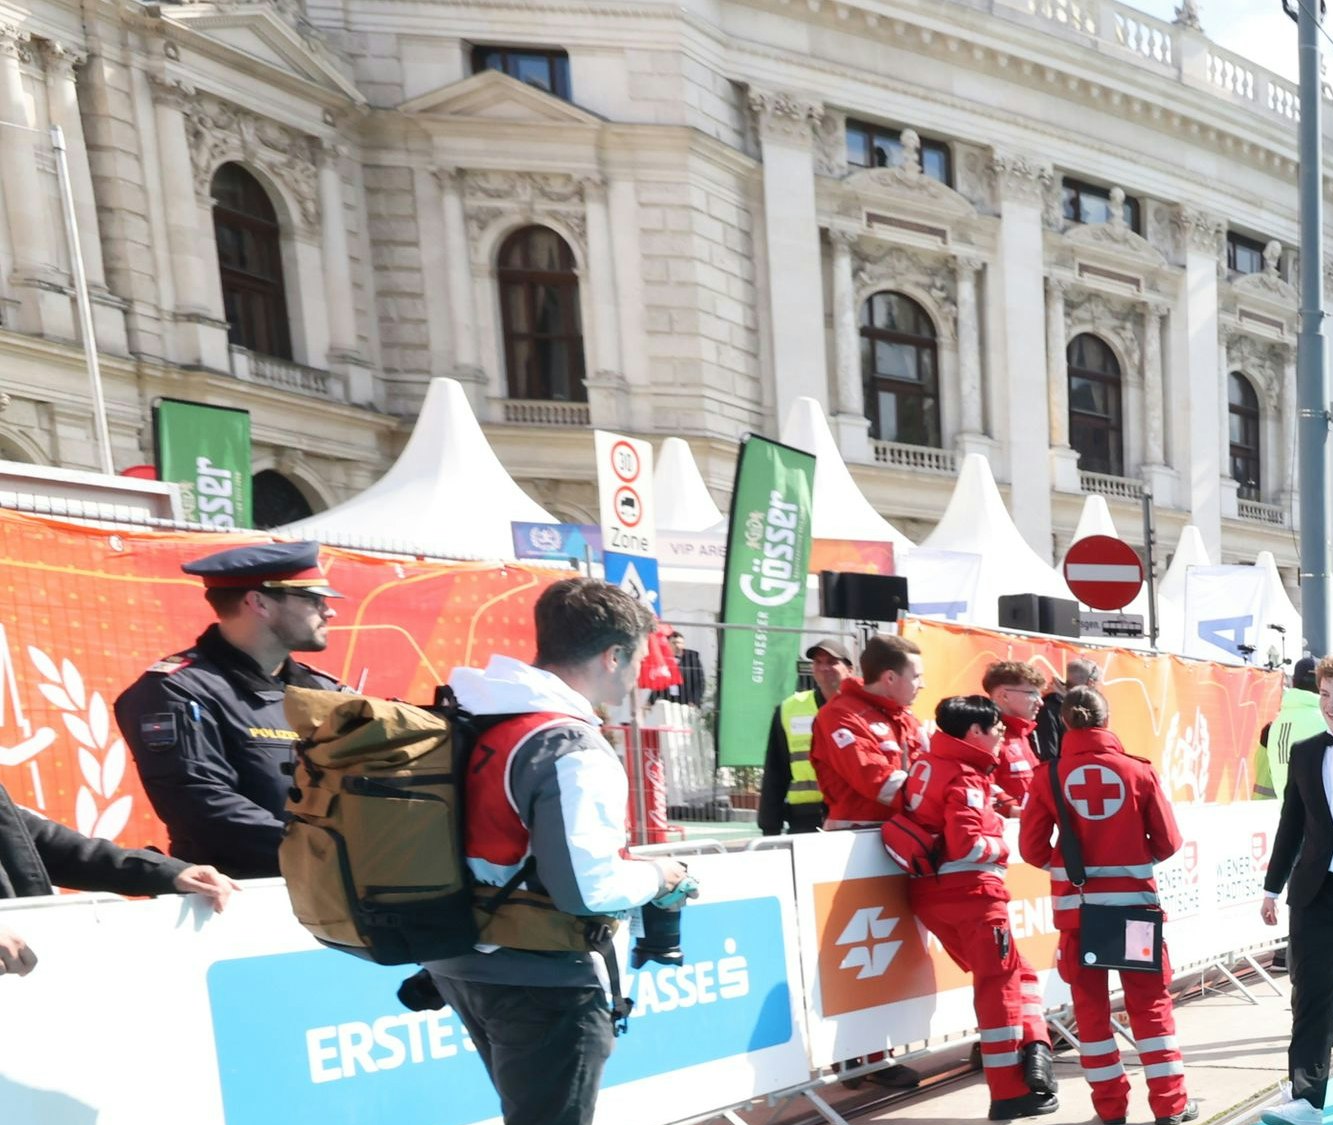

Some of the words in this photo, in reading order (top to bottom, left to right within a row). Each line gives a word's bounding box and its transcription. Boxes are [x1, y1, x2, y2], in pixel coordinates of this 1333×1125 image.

[611, 526, 649, 551] Zone
[739, 490, 799, 607] Gösser
[305, 1008, 458, 1084] ERSTE
